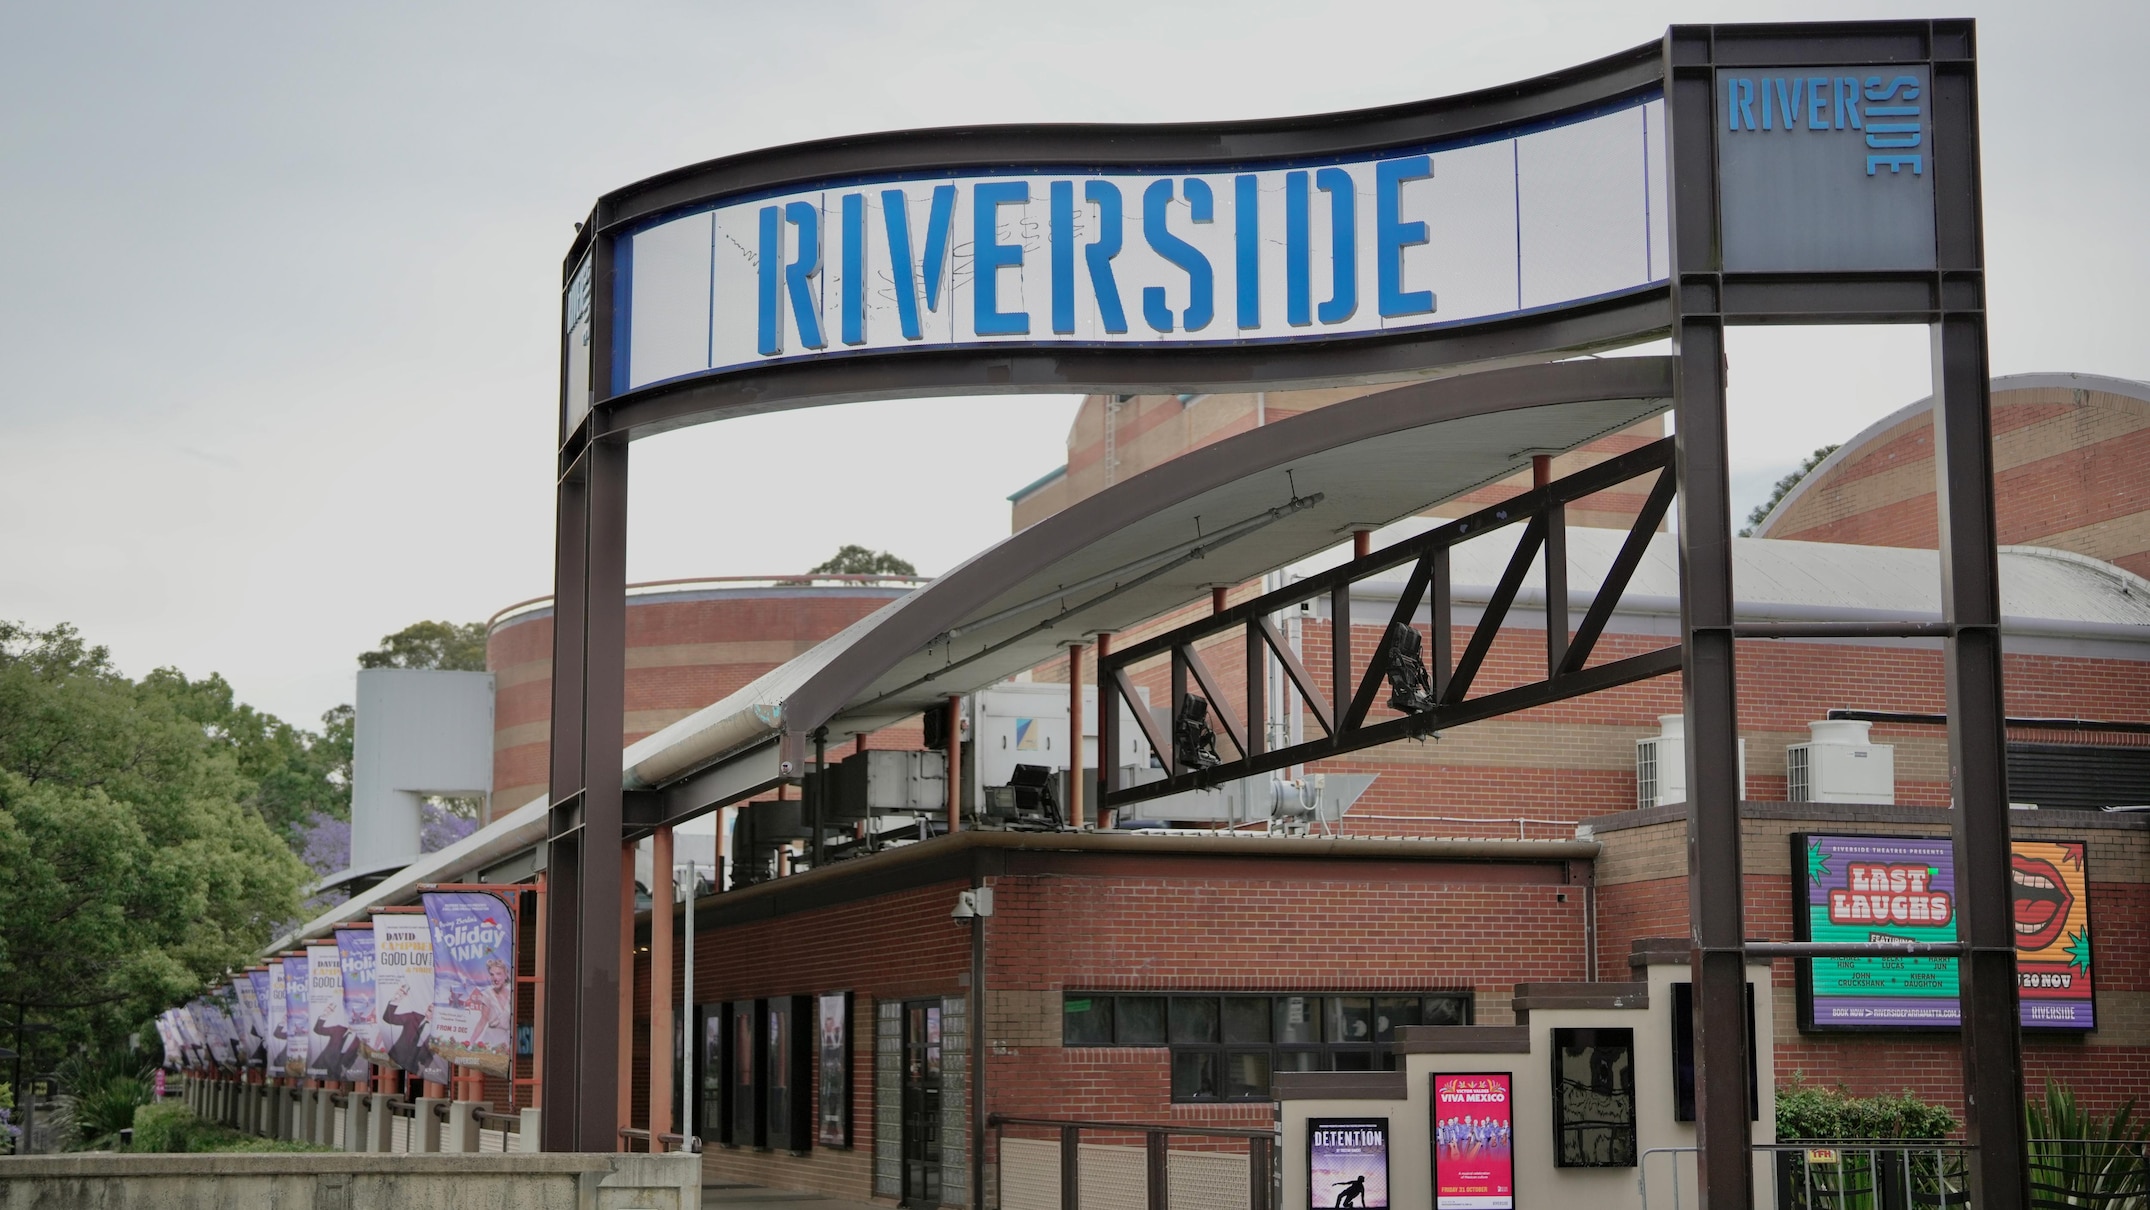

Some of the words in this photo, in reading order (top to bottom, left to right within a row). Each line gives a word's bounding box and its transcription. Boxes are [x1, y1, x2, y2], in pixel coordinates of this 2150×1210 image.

[1728, 77, 1862, 131] RIVER
[1864, 75, 1922, 176] SIDE
[757, 154, 1437, 356] RIVERSIDE
[1852, 868, 1926, 893] LAST
[1833, 894, 1947, 921] LAUGHS
[386, 932, 416, 941] DAVID
[381, 951, 407, 966] GOOD
[410, 952, 432, 966] LOV
[1837, 961, 1855, 969] HING
[312, 976, 335, 988] GOOD
[1838, 979, 1885, 987] CRUCKSHANK
[1904, 980, 1943, 988] DAUGHTON
[2023, 973, 2040, 987] 20
[2041, 974, 2072, 988] NOV
[1832, 1008, 1849, 1017] BOOK
[1850, 1009, 1864, 1017] NOW
[2031, 1006, 2076, 1020] RIVERSIDE
[436, 1024, 452, 1033] FROM
[1441, 1093, 1465, 1103] VIVA
[1466, 1093, 1505, 1103] MEXICO
[1314, 1130, 1382, 1147] DETENTION
